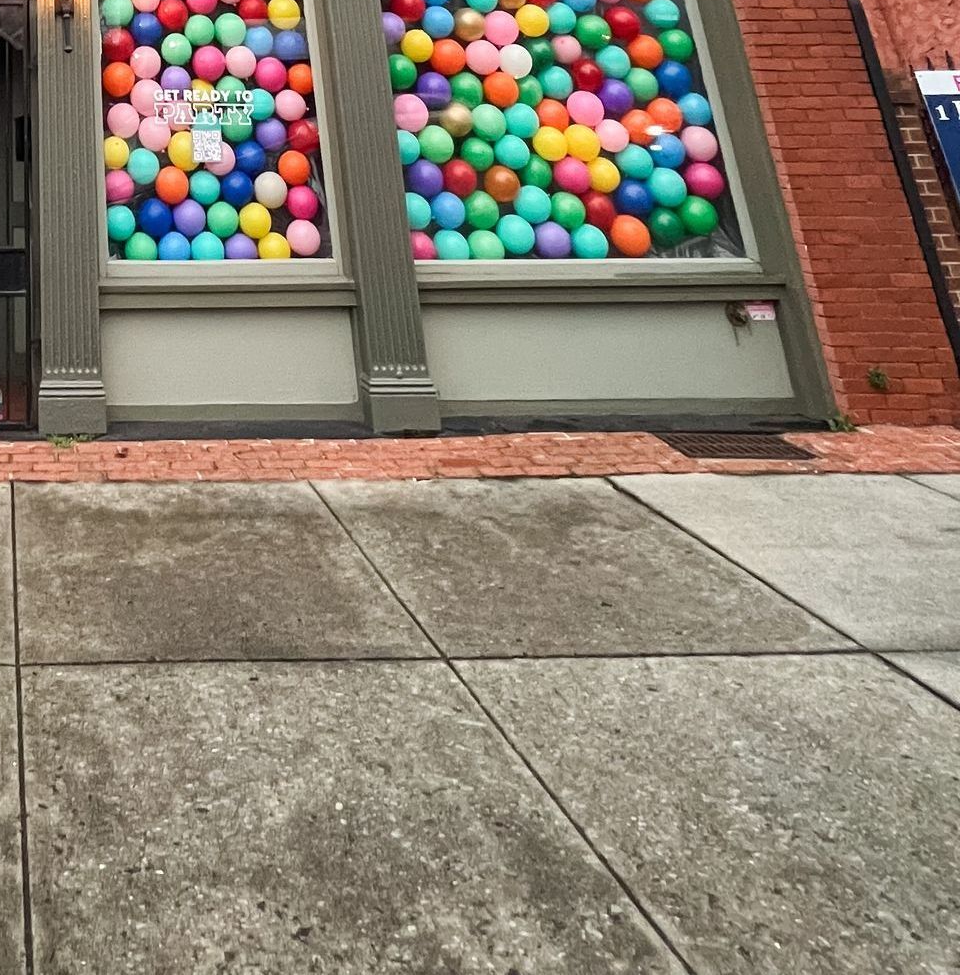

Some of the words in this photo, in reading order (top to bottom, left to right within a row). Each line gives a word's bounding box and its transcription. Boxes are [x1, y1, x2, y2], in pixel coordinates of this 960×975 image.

[153, 89, 180, 102] GET
[183, 89, 231, 102] READY
[235, 90, 254, 102] TO
[153, 102, 255, 125] PARTY
